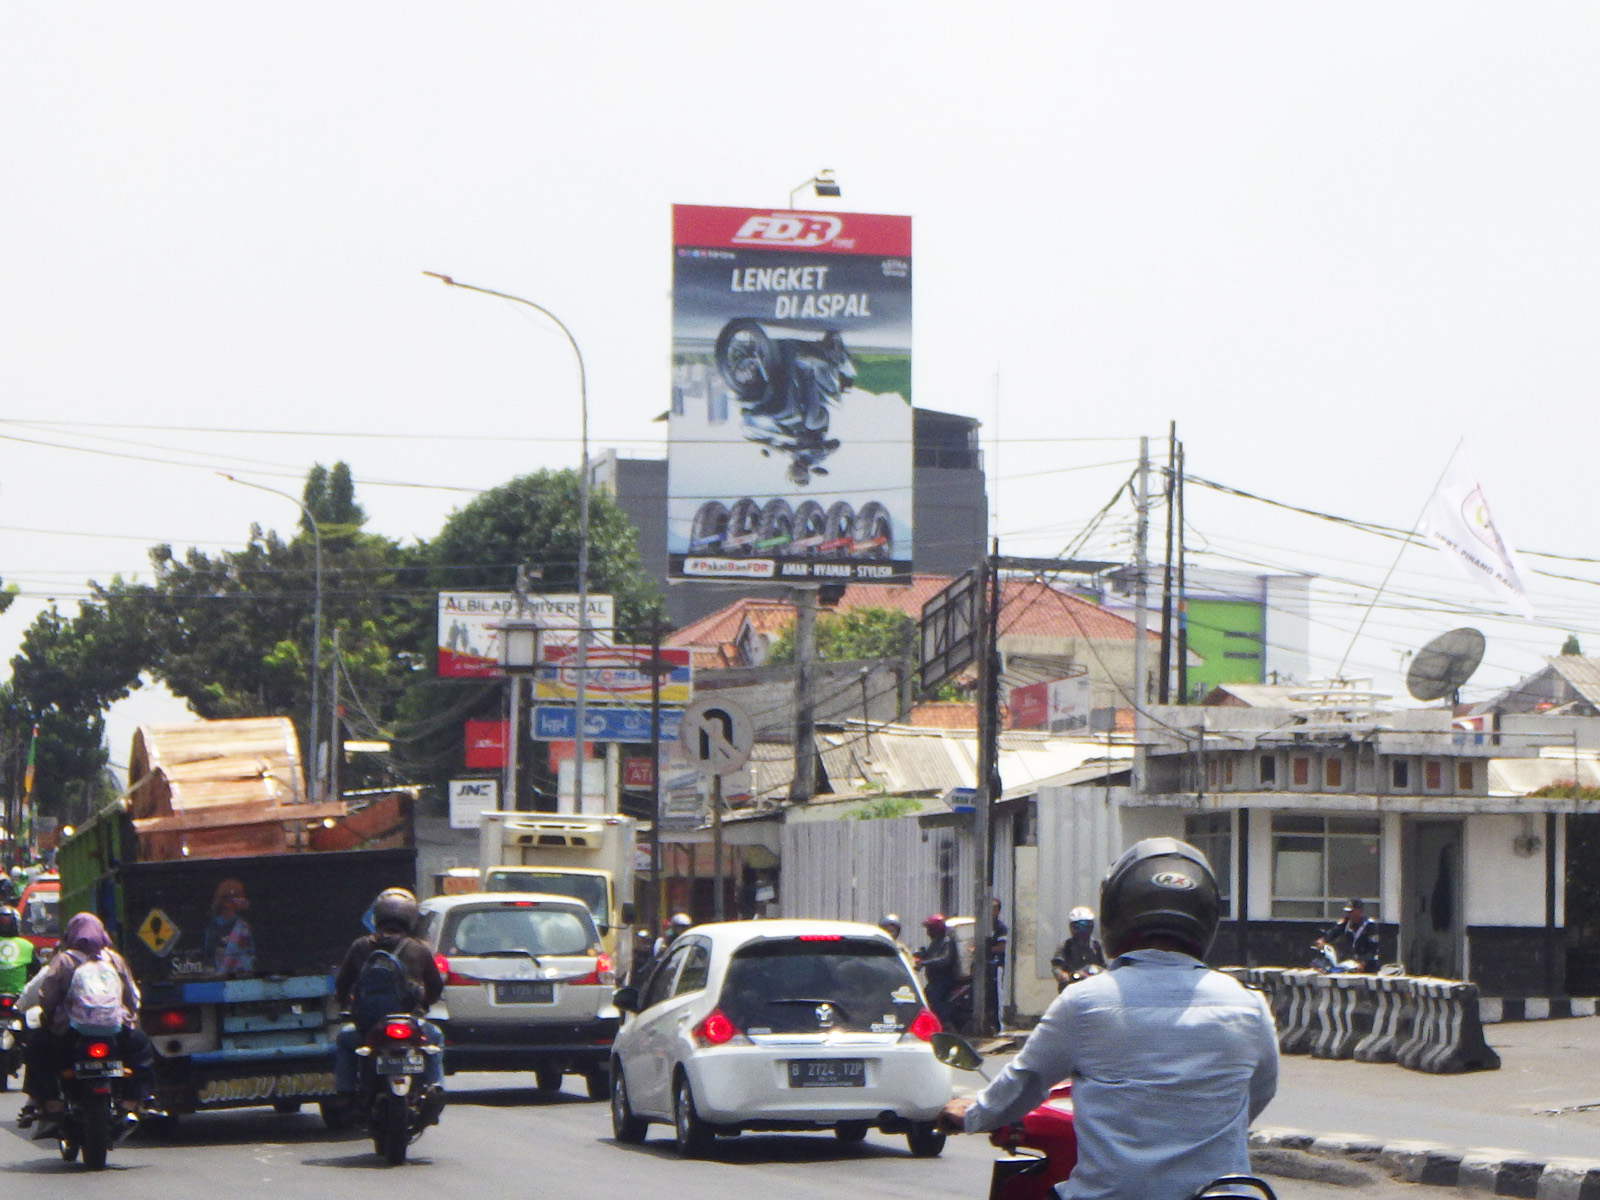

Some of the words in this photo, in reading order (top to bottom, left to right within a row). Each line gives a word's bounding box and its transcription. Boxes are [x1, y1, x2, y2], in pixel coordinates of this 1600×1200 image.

[731, 213, 843, 247] FDR
[731, 266, 828, 292] LENGKET
[775, 295, 799, 319] DI
[801, 293, 871, 318] ASPAL
[1460, 549, 1494, 575] PINANG
[445, 596, 513, 613] ALBILAD
[456, 784, 492, 797] JNE
[792, 1063, 800, 1076] B
